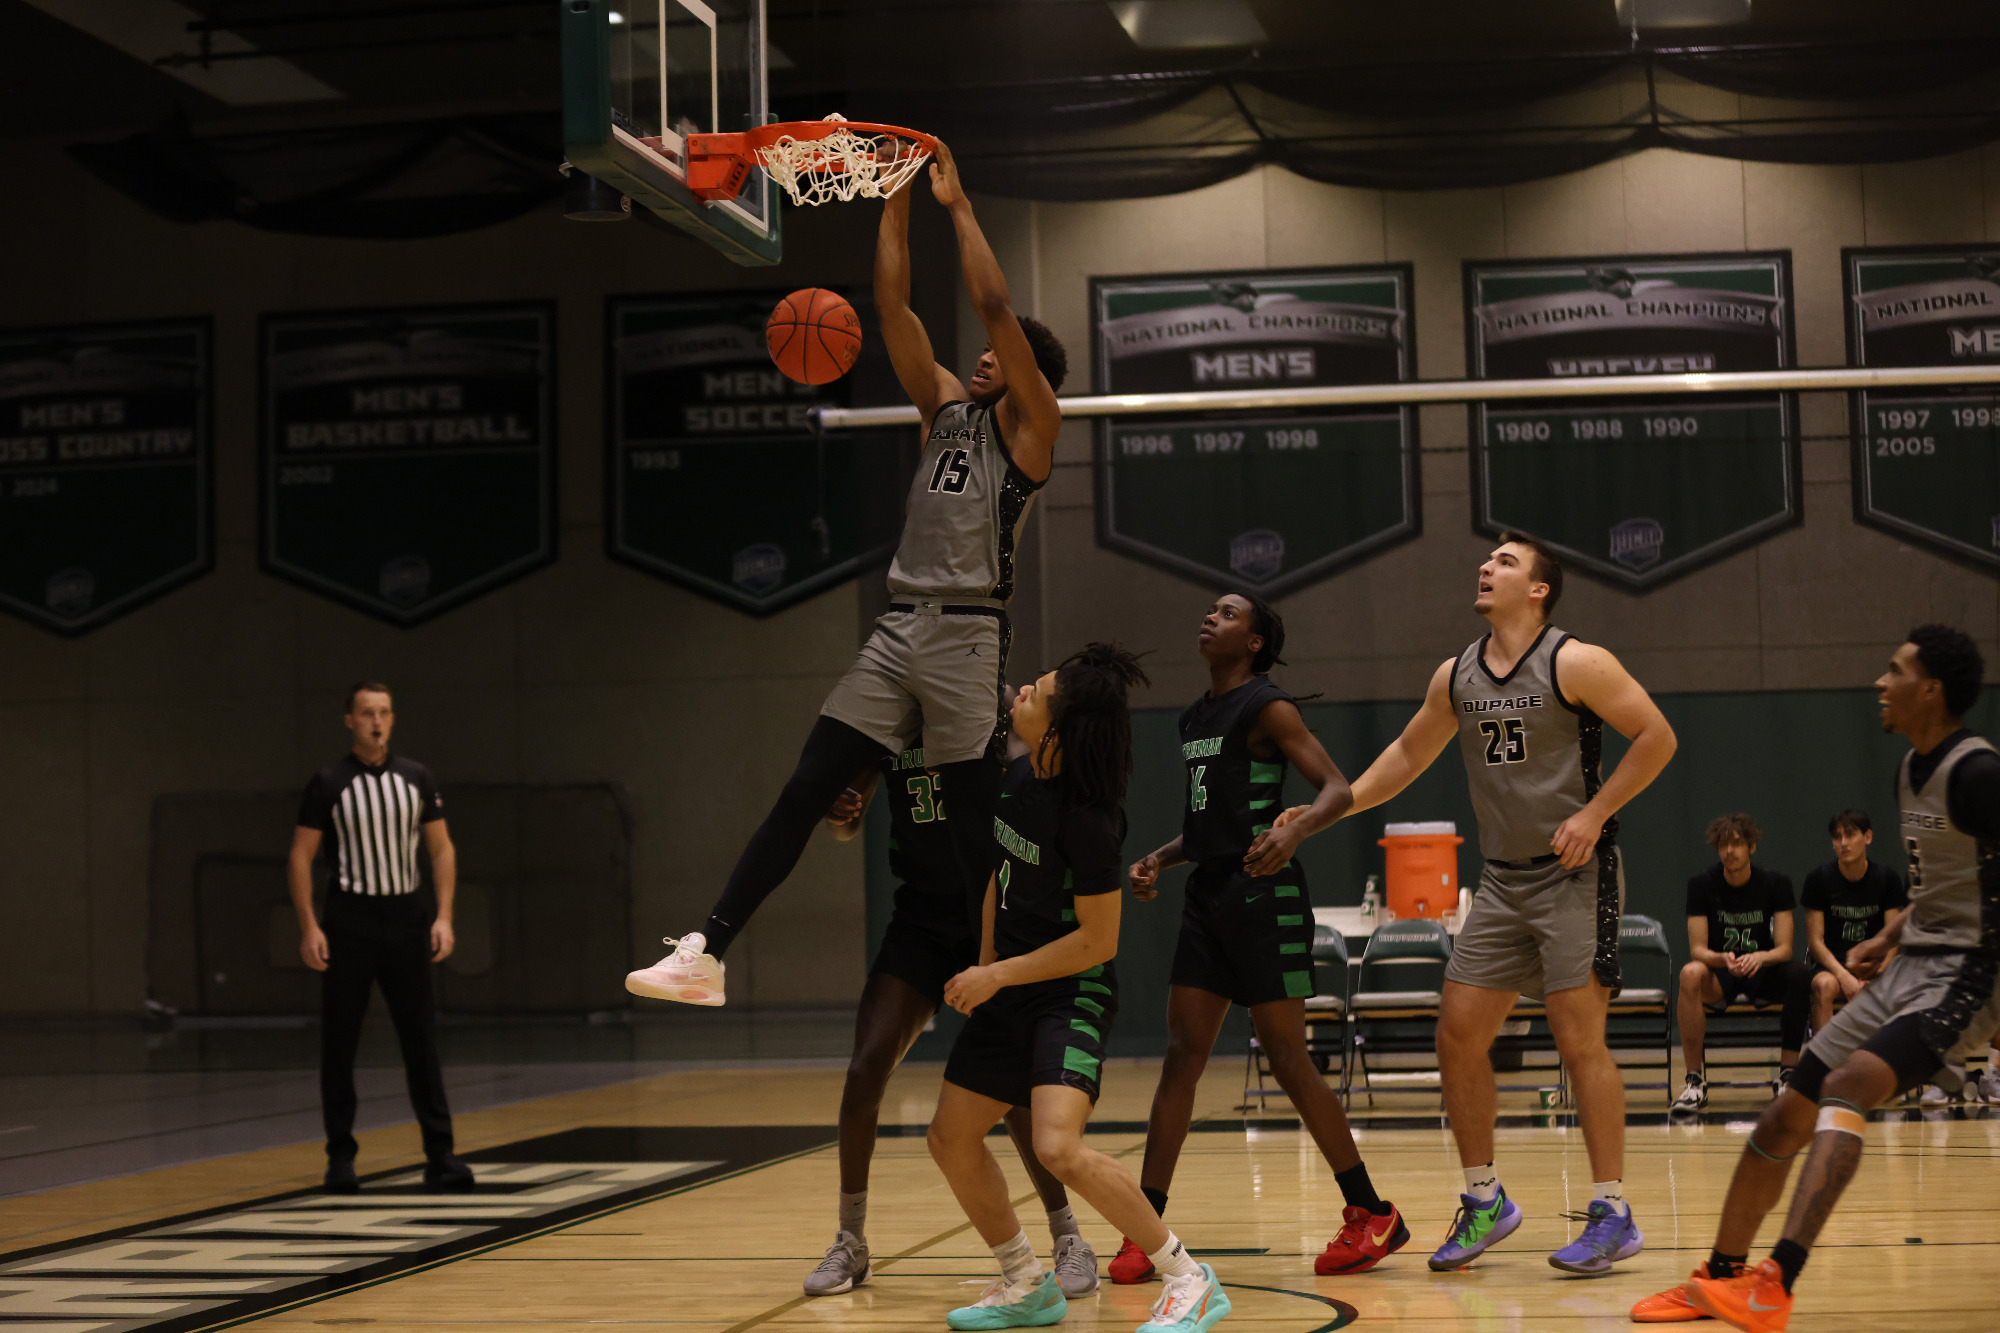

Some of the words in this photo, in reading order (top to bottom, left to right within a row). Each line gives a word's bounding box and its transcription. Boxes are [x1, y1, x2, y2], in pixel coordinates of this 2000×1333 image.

[1497, 303, 1613, 330] NATIONAL
[1625, 300, 1766, 326] CHAMPIONS
[1877, 291, 1994, 319] NATIONAL
[1122, 318, 1236, 346] NATIONAL
[1249, 314, 1388, 339] CHAMPIONS
[1191, 349, 1316, 383] MEN'S
[704, 370, 820, 396] MENS
[351, 384, 464, 413] MEN'S
[21, 399, 126, 430] MEN'S
[684, 402, 836, 432] SOCCE
[1496, 421, 1551, 442] 1980
[1570, 418, 1623, 440] 1988
[1642, 416, 1698, 438] 1990
[1878, 409, 1931, 430] 1997
[57, 427, 194, 460] COUNTRY
[285, 414, 532, 449] BASKETBALL
[1120, 434, 1175, 456] 1996
[1192, 430, 1246, 453] 1997
[1264, 428, 1319, 450] 1998
[1876, 437, 1937, 457] 2005
[927, 448, 972, 495] 15
[1461, 695, 1544, 714] DUPAGE
[1478, 717, 1527, 766] 25
